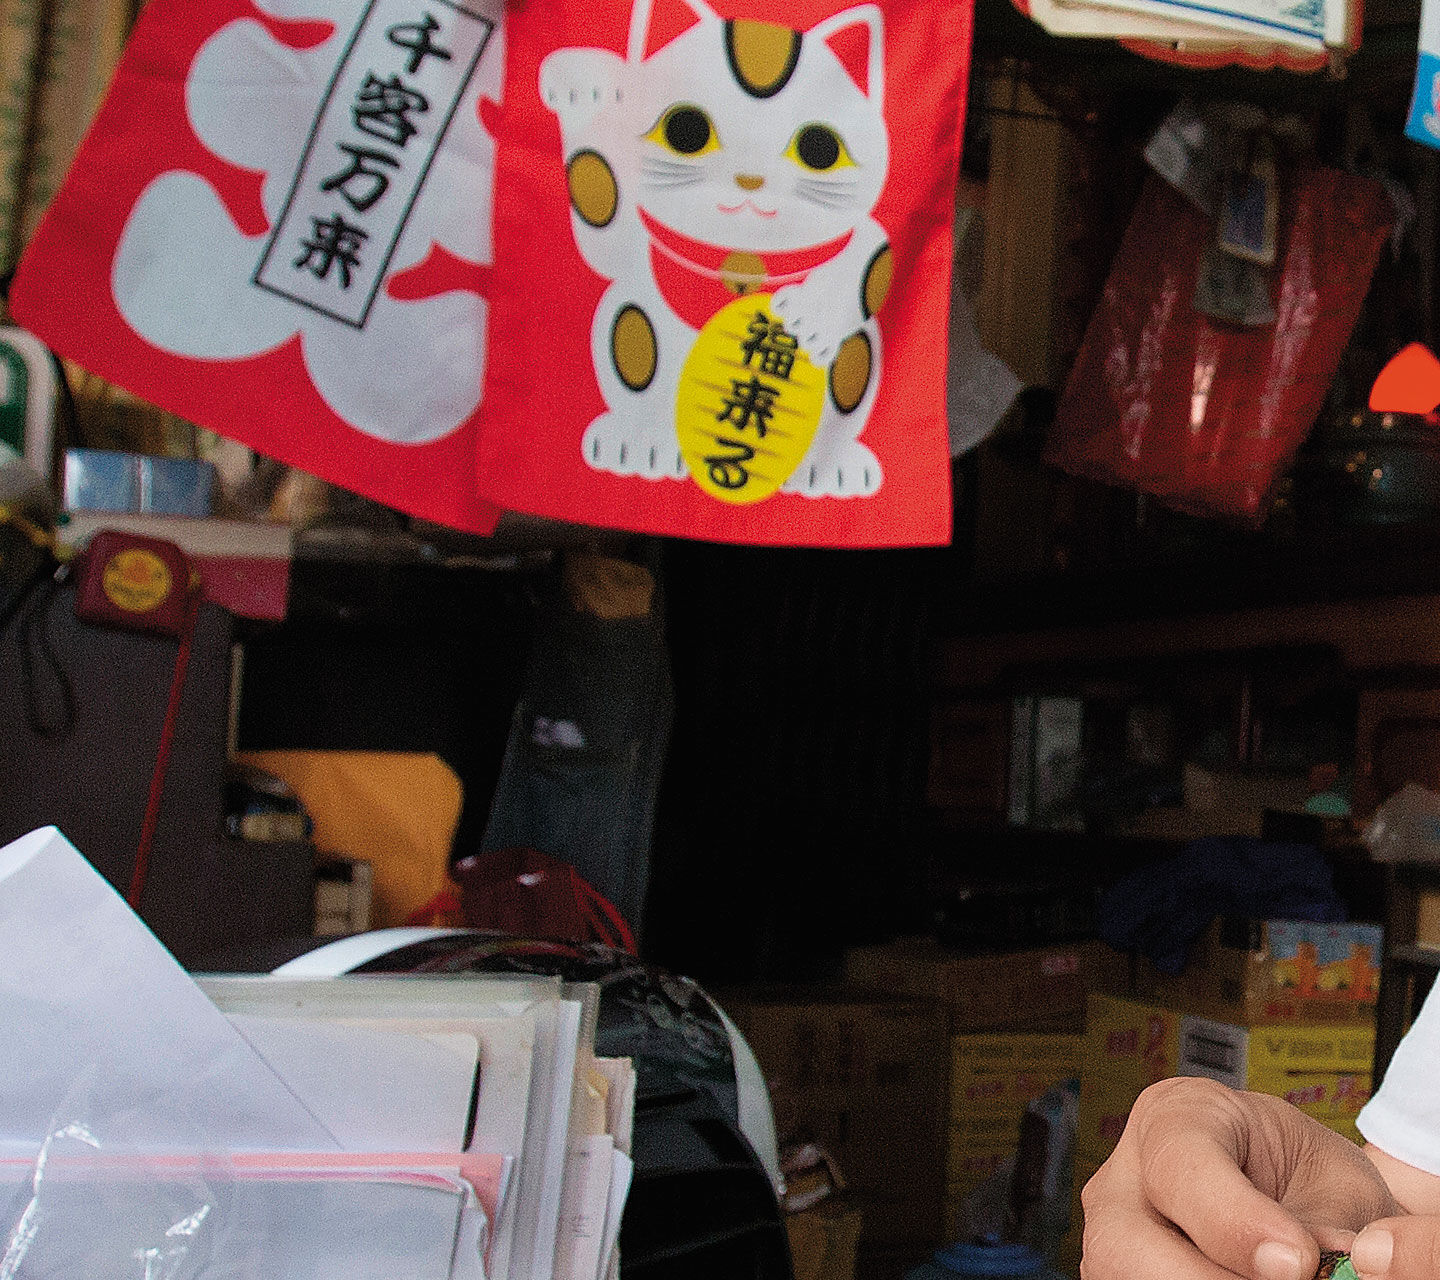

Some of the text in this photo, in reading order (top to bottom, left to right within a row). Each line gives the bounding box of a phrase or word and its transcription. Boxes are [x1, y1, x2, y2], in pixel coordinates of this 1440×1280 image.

[294, 13, 456, 292] 千客万来
[705, 308, 801, 491] 福来る
